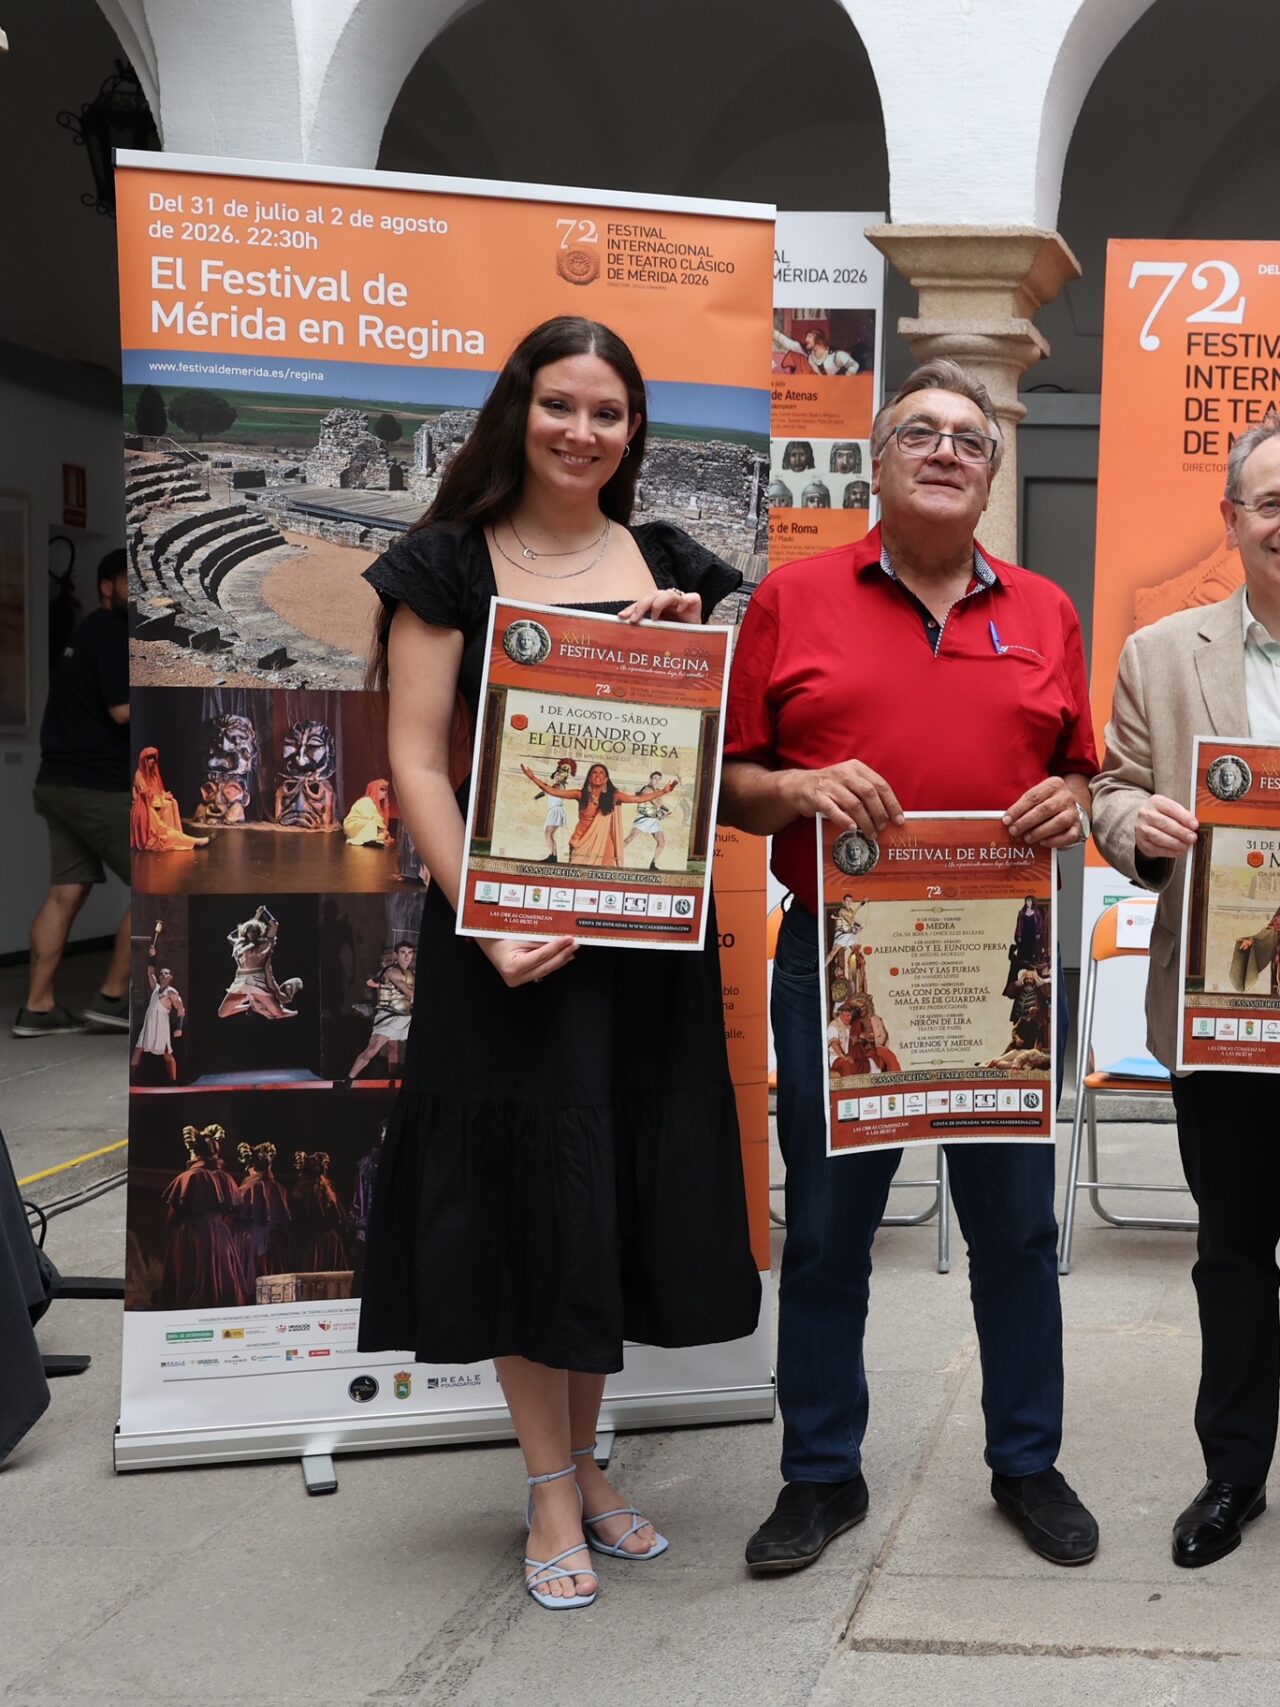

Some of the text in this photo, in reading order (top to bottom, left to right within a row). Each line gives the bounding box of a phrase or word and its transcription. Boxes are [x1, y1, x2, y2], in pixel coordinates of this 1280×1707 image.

[149, 193, 448, 235] Del 31 de julio al 2 de agosto
[148, 220, 318, 250] de 2026. 22:30h
[556, 218, 599, 250] 72
[607, 224, 666, 240] FESTIVAL
[607, 238, 714, 258] INTERNACIONAL
[607, 253, 735, 274] DE TEATRO CLÁSICO
[150, 256, 408, 308] El Festival de
[607, 267, 625, 281] DE
[628, 266, 678, 285] MÉRIDA
[681, 273, 709, 287] 2026
[833, 269, 868, 284] 2026
[1128, 260, 1246, 351] 72
[151, 300, 485, 360] Mérida en Regina
[149, 361, 324, 381] www.festivaldemerida.es/regina
[771, 390, 818, 401] de Atenas
[1185, 397, 1220, 423] DE
[1183, 430, 1219, 456] DE
[777, 522, 788, 534] de
[791, 523, 818, 534] Roma
[560, 644, 709, 672] FESTIVAL DE REGINA
[595, 683, 611, 696] 72
[540, 705, 668, 727] 1 DE AGOSTO SÁBADO
[546, 721, 661, 744] ALEJANDRO Y
[529, 732, 679, 758] EL EUNUCO PERSA
[1246, 840, 1257, 850] 31
[1260, 841, 1275, 850] DE
[888, 847, 1035, 860] FESTIVAL DE REGINA
[927, 886, 941, 898] 72
[926, 922, 955, 931] MEDEA
[874, 945, 923, 954] ALEJANDRO
[944, 943, 981, 951] EUNUCO
[982, 943, 1008, 951] PERSA
[901, 965, 981, 975] JASÓN Y LAS FURIAS
[888, 987, 991, 998] CASA CON DOS PUERTAS,
[894, 998, 920, 1006] MALA
[932, 996, 942, 1004] DE
[944, 995, 987, 1004] GUARDAR
[910, 1017, 972, 1027] NERÓN DE LIRA
[899, 1038, 983, 1050] SATURNOS Y MEDEAS
[440, 1374, 481, 1383] REALE
[440, 1380, 481, 1388] FOUNDATION
